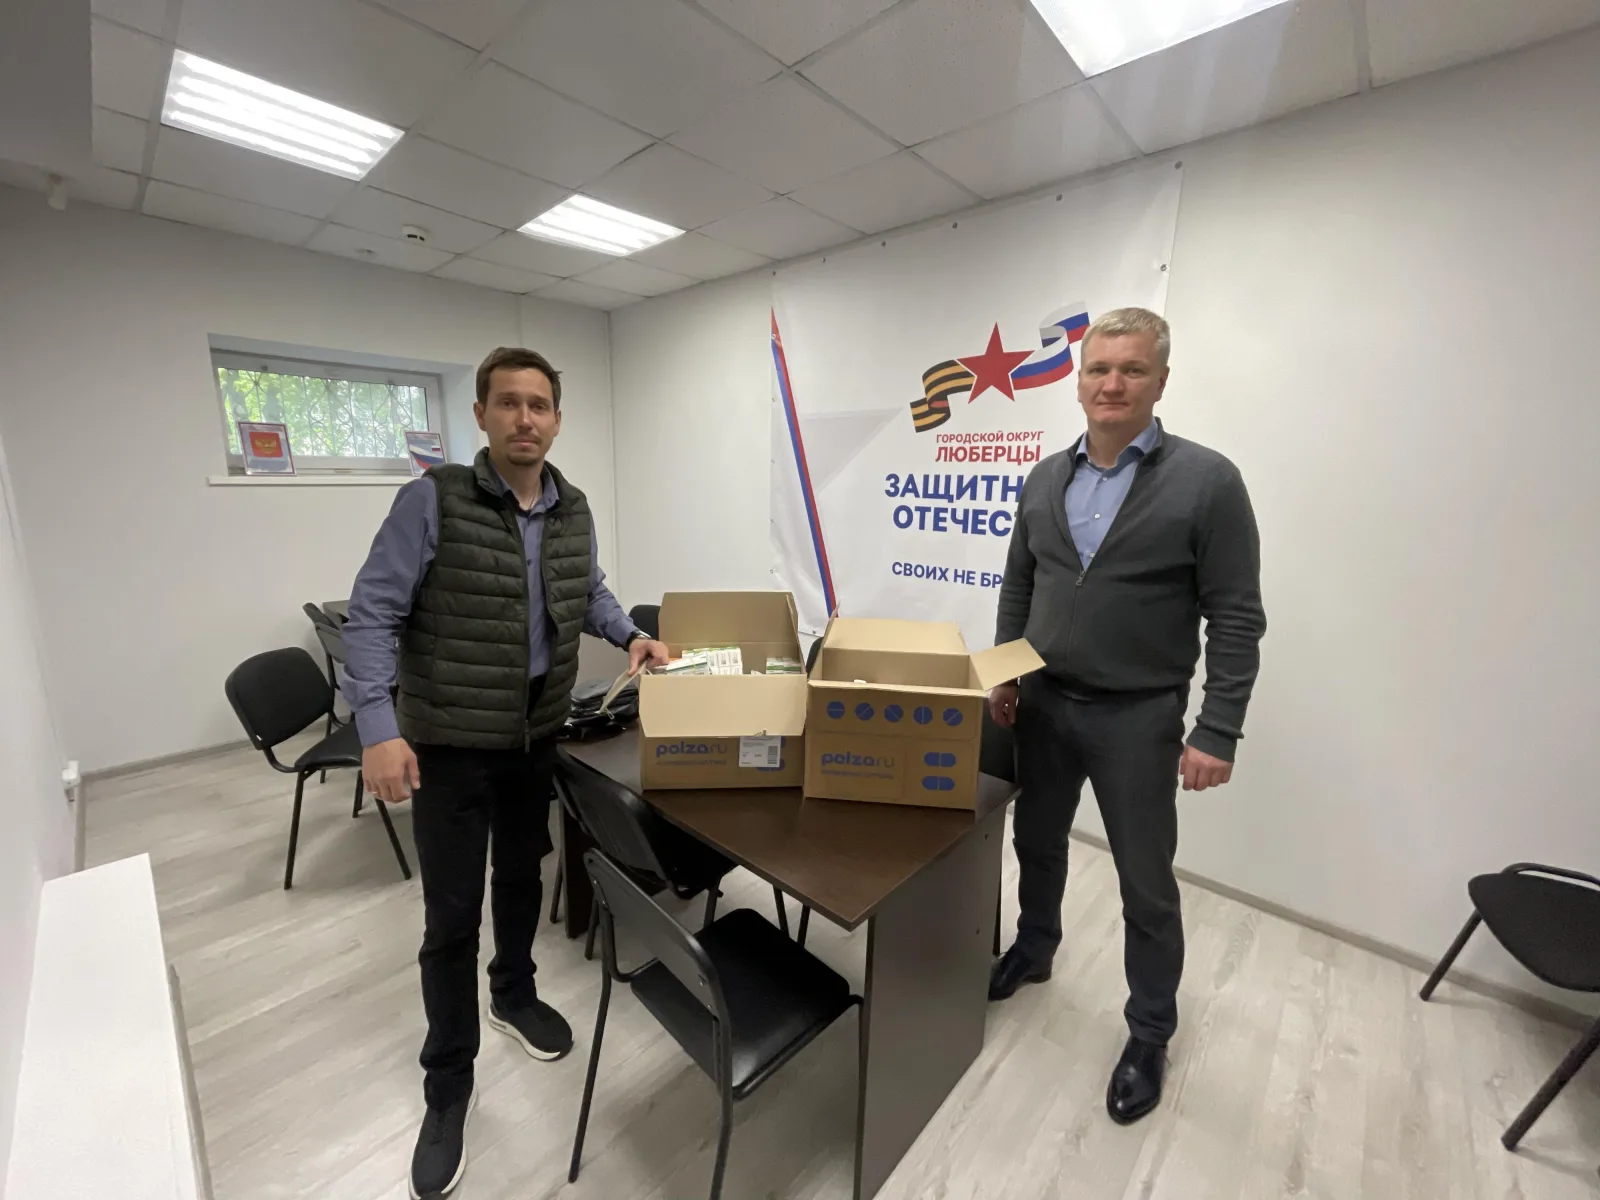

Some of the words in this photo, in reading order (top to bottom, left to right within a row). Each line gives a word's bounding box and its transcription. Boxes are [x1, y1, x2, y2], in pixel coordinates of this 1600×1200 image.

[936, 430, 1004, 444] ГОРОДСКОЙ
[1006, 431, 1045, 442] ОКРУГ
[935, 445, 1041, 466] ЛЮБЕРЦЫ
[893, 504, 1018, 537] ОТЕЧЕС
[891, 561, 949, 582] СВОИХ
[953, 568, 976, 586] НЕ
